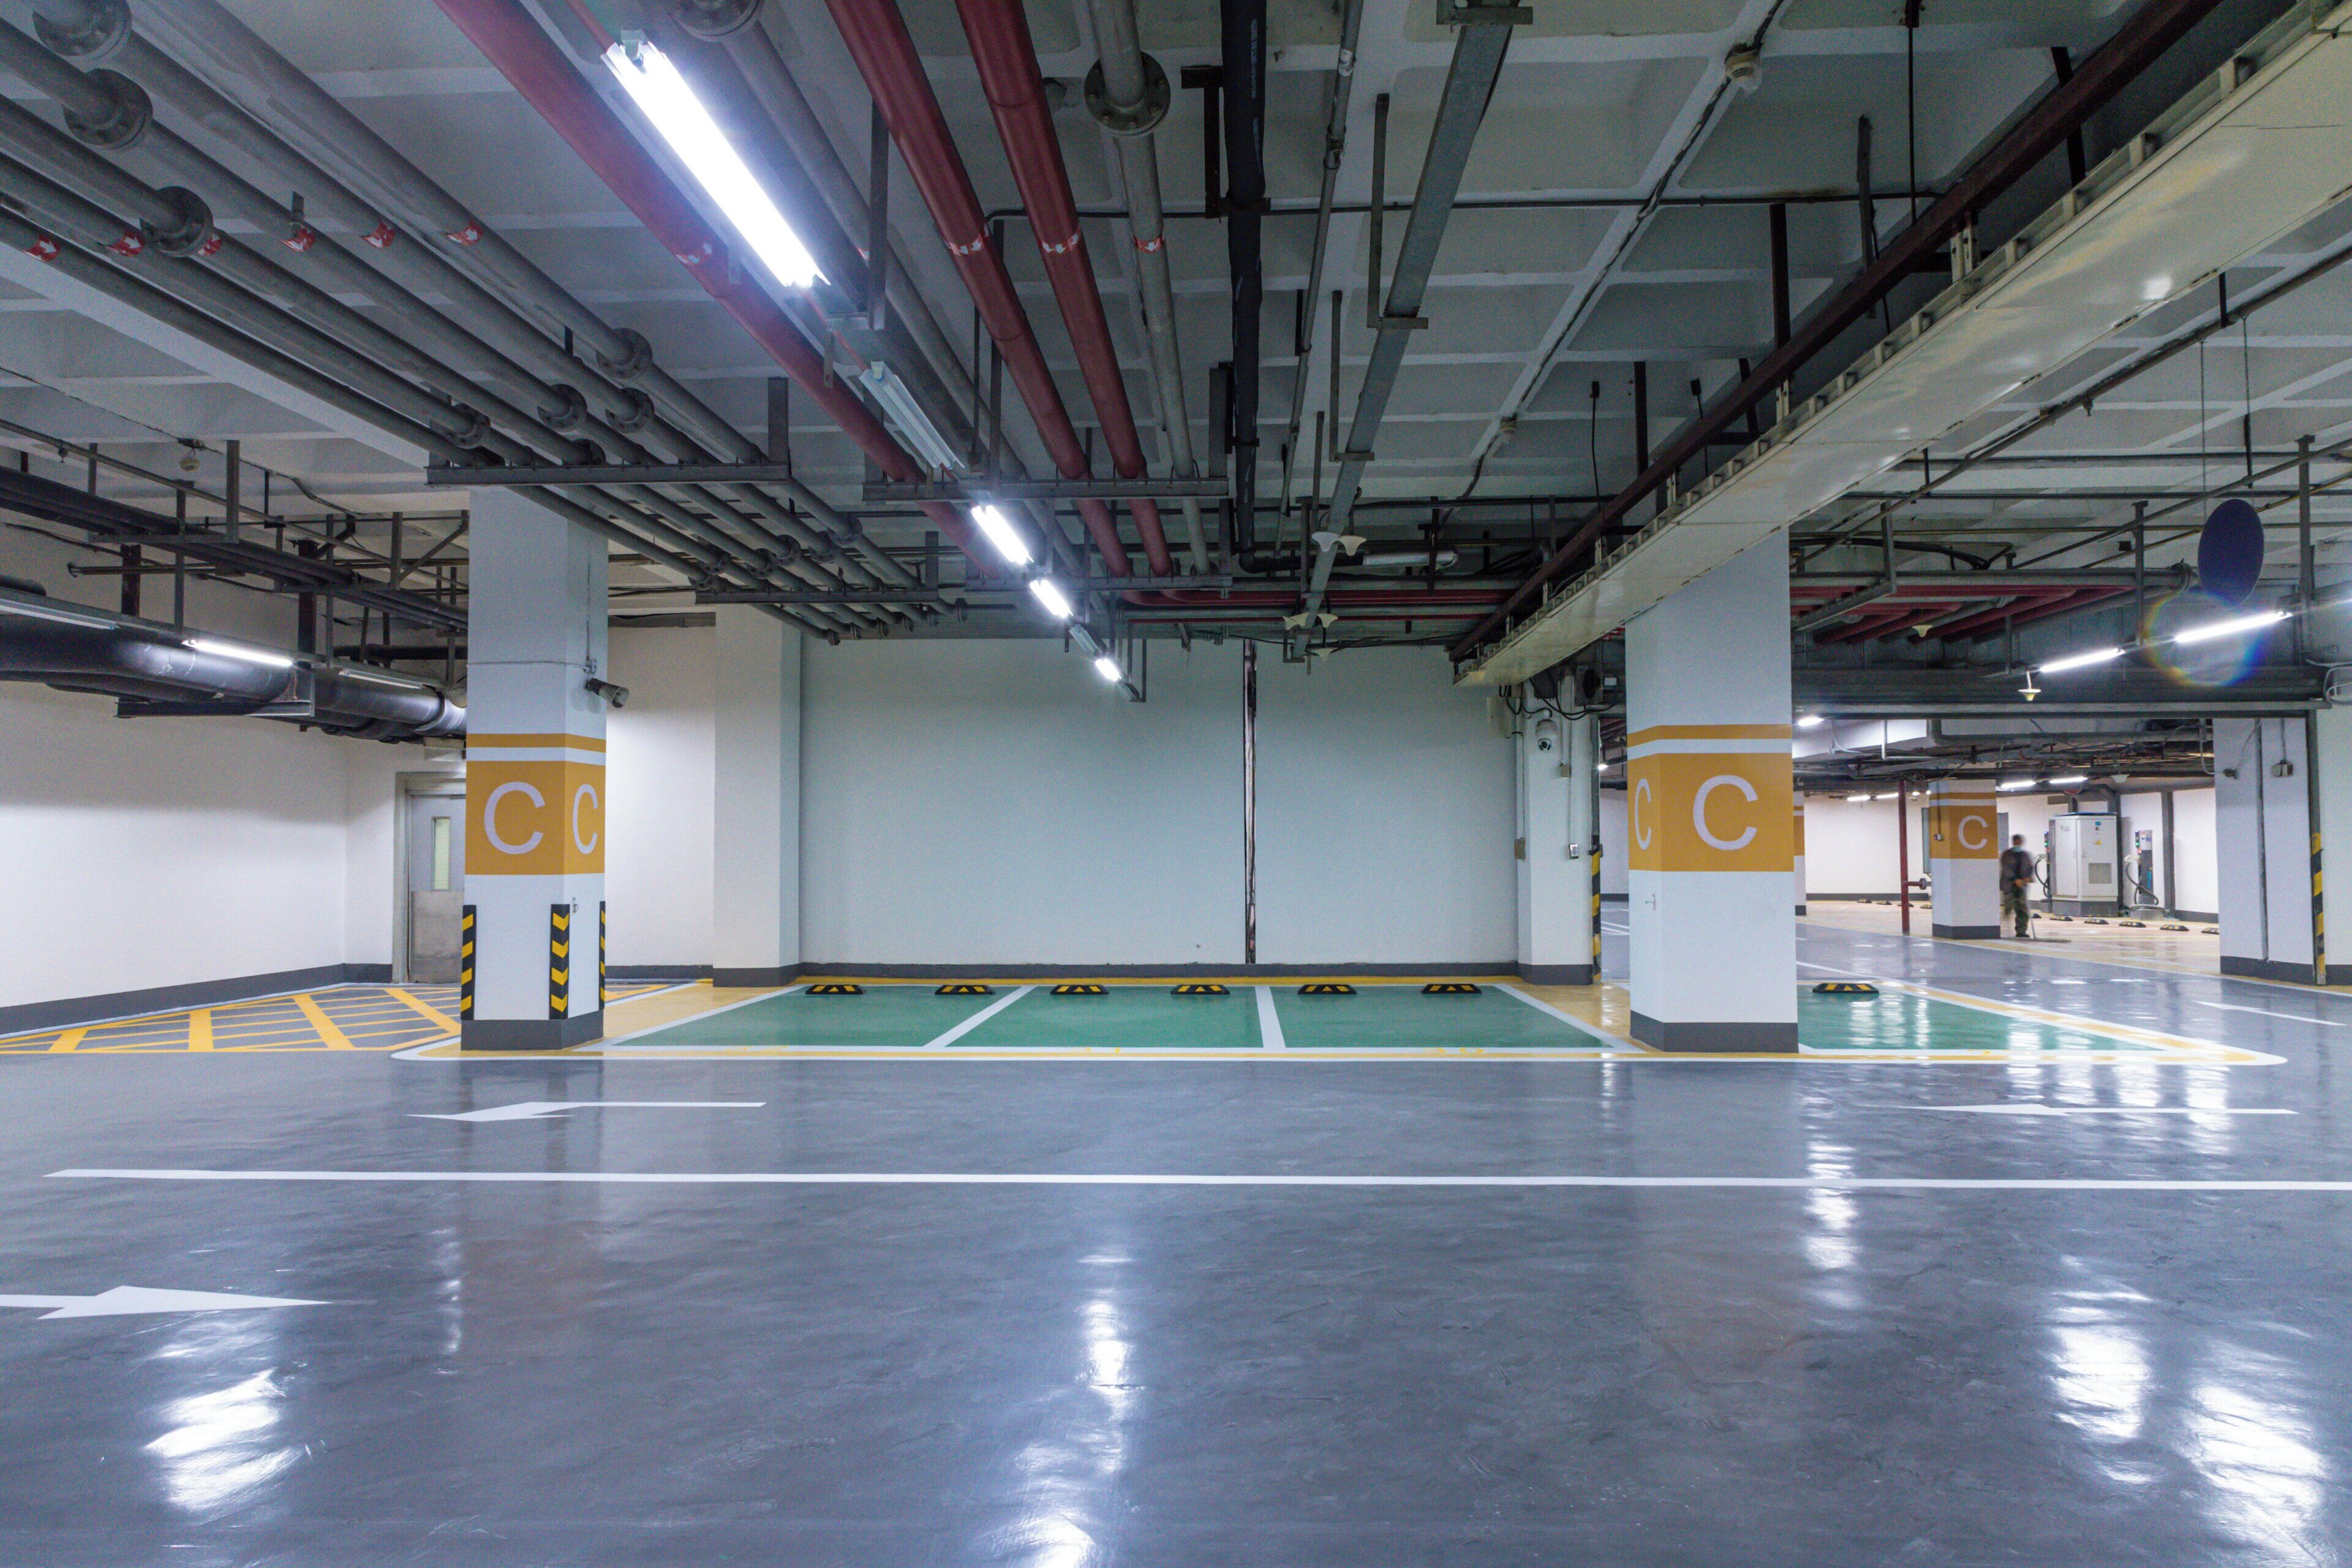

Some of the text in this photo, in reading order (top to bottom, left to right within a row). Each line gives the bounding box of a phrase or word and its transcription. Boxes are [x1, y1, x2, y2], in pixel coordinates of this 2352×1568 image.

[484, 781, 545, 855] C
[572, 783, 598, 855] C
[1634, 778, 1652, 850] C
[1693, 774, 1758, 851] C
[1958, 815, 1988, 850] C
